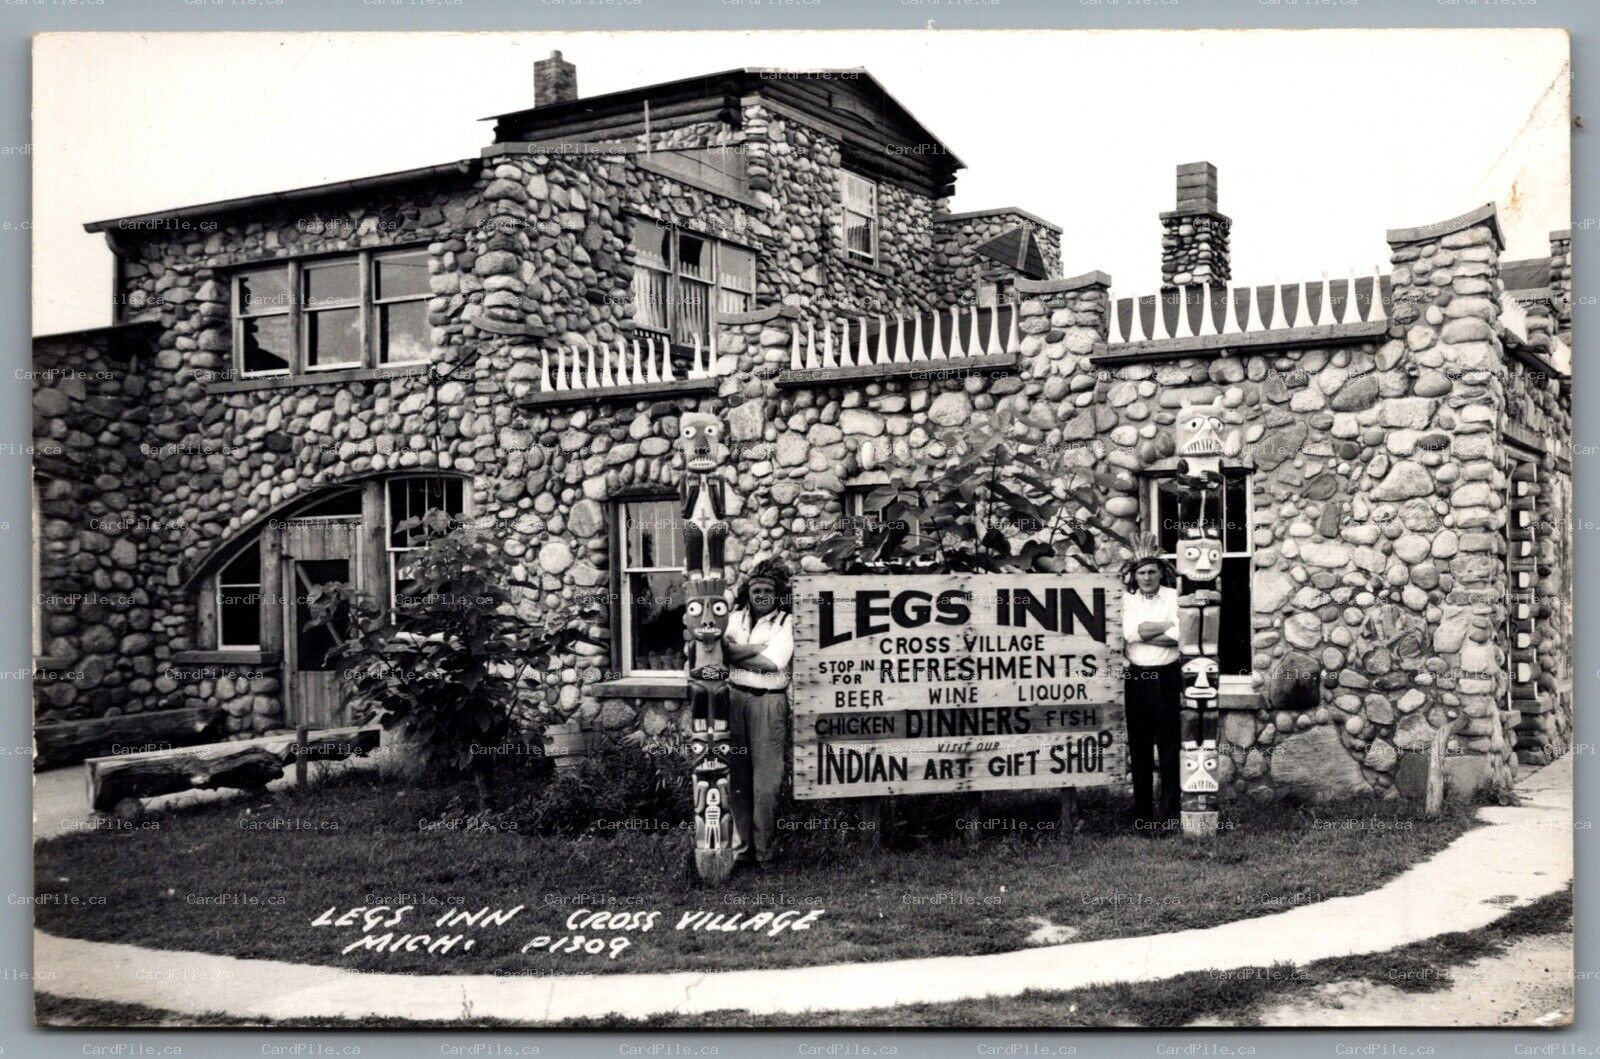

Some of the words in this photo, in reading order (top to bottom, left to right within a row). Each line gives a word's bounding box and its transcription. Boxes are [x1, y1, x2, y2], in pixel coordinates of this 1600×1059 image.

[818, 589, 972, 650] LEGS
[996, 587, 1107, 644] INN
[880, 637, 950, 655] CROSS
[963, 634, 1045, 653] VILLAGE
[818, 660, 854, 675] STOP
[860, 659, 874, 672] IN
[880, 654, 1098, 684] REFRESHMENTS
[832, 674, 862, 685] FOR
[835, 690, 884, 708] BEER
[929, 687, 978, 705] WINE
[1018, 684, 1088, 702] LIQUOR
[815, 715, 896, 736] CHICKEN
[906, 706, 1031, 739] DINNERS
[1045, 709, 1097, 727] FISH
[817, 742, 908, 786] INDIAN
[924, 758, 973, 781] ART
[988, 750, 1040, 777] GIFT
[1050, 730, 1114, 775] SHOP
[937, 742, 969, 754] VISIT
[977, 741, 1000, 752] OUR
